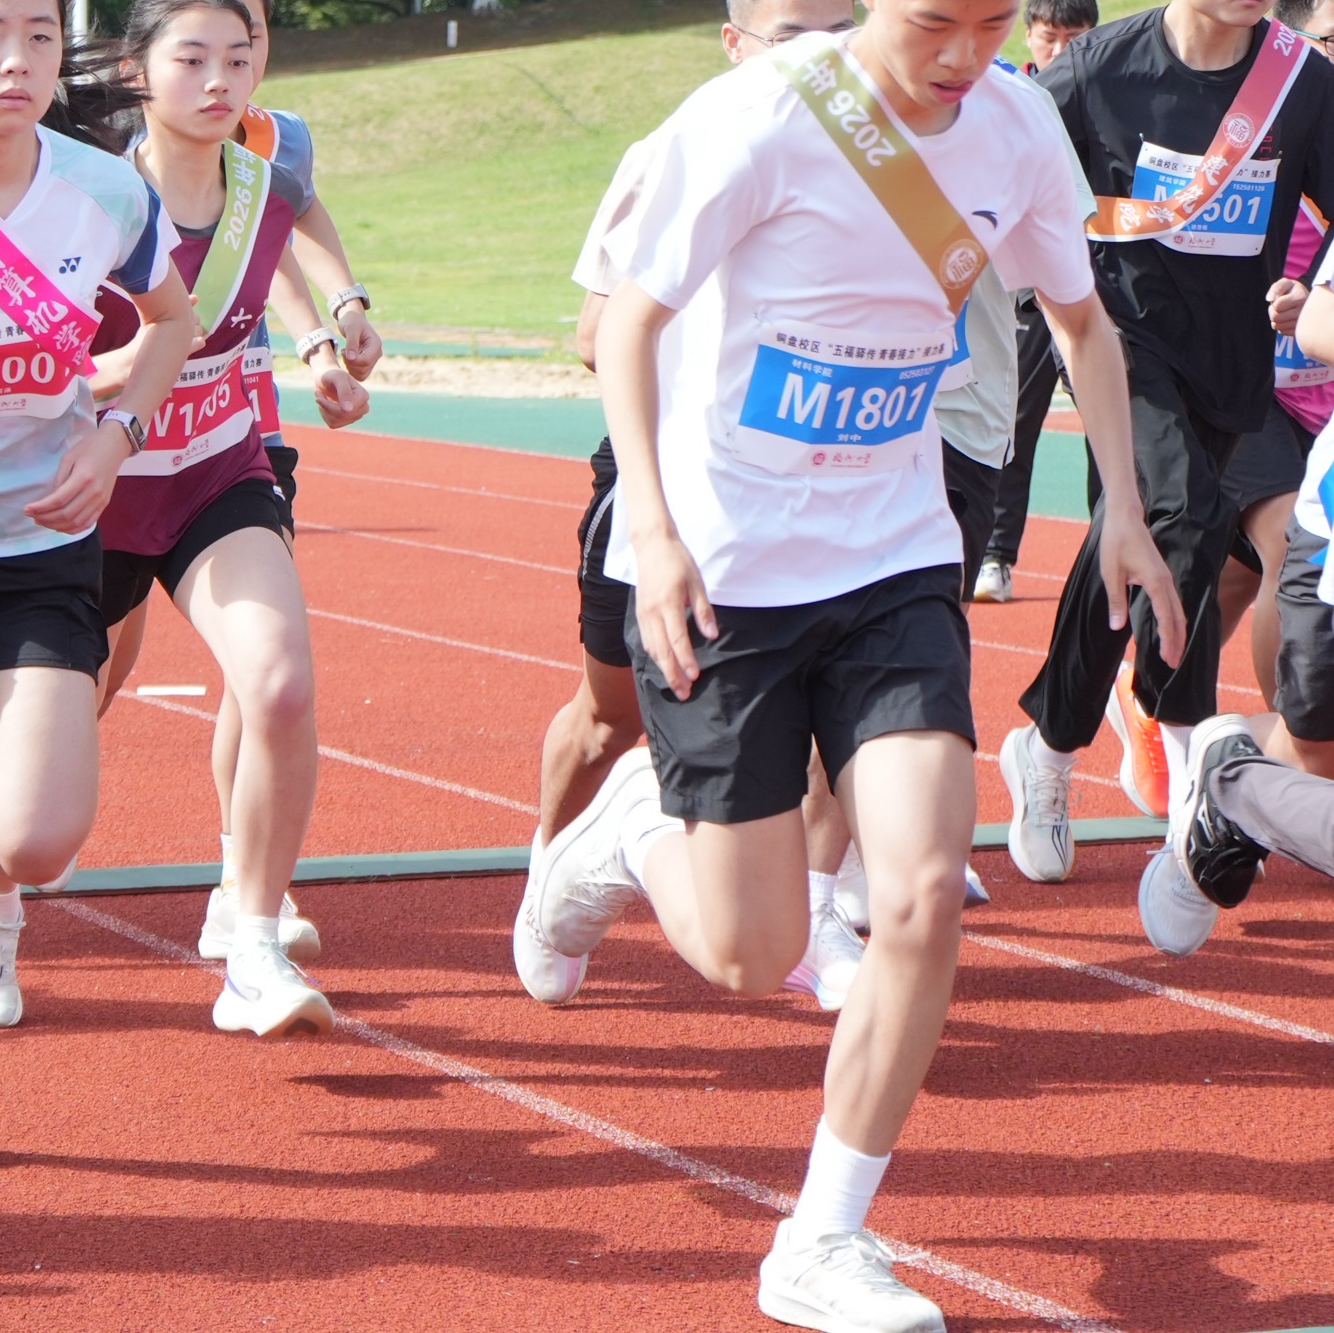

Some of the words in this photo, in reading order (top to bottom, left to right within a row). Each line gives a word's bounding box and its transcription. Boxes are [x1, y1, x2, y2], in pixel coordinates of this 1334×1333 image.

[776, 332, 822, 354] 铜盘校区
[776, 372, 927, 431] M1801
